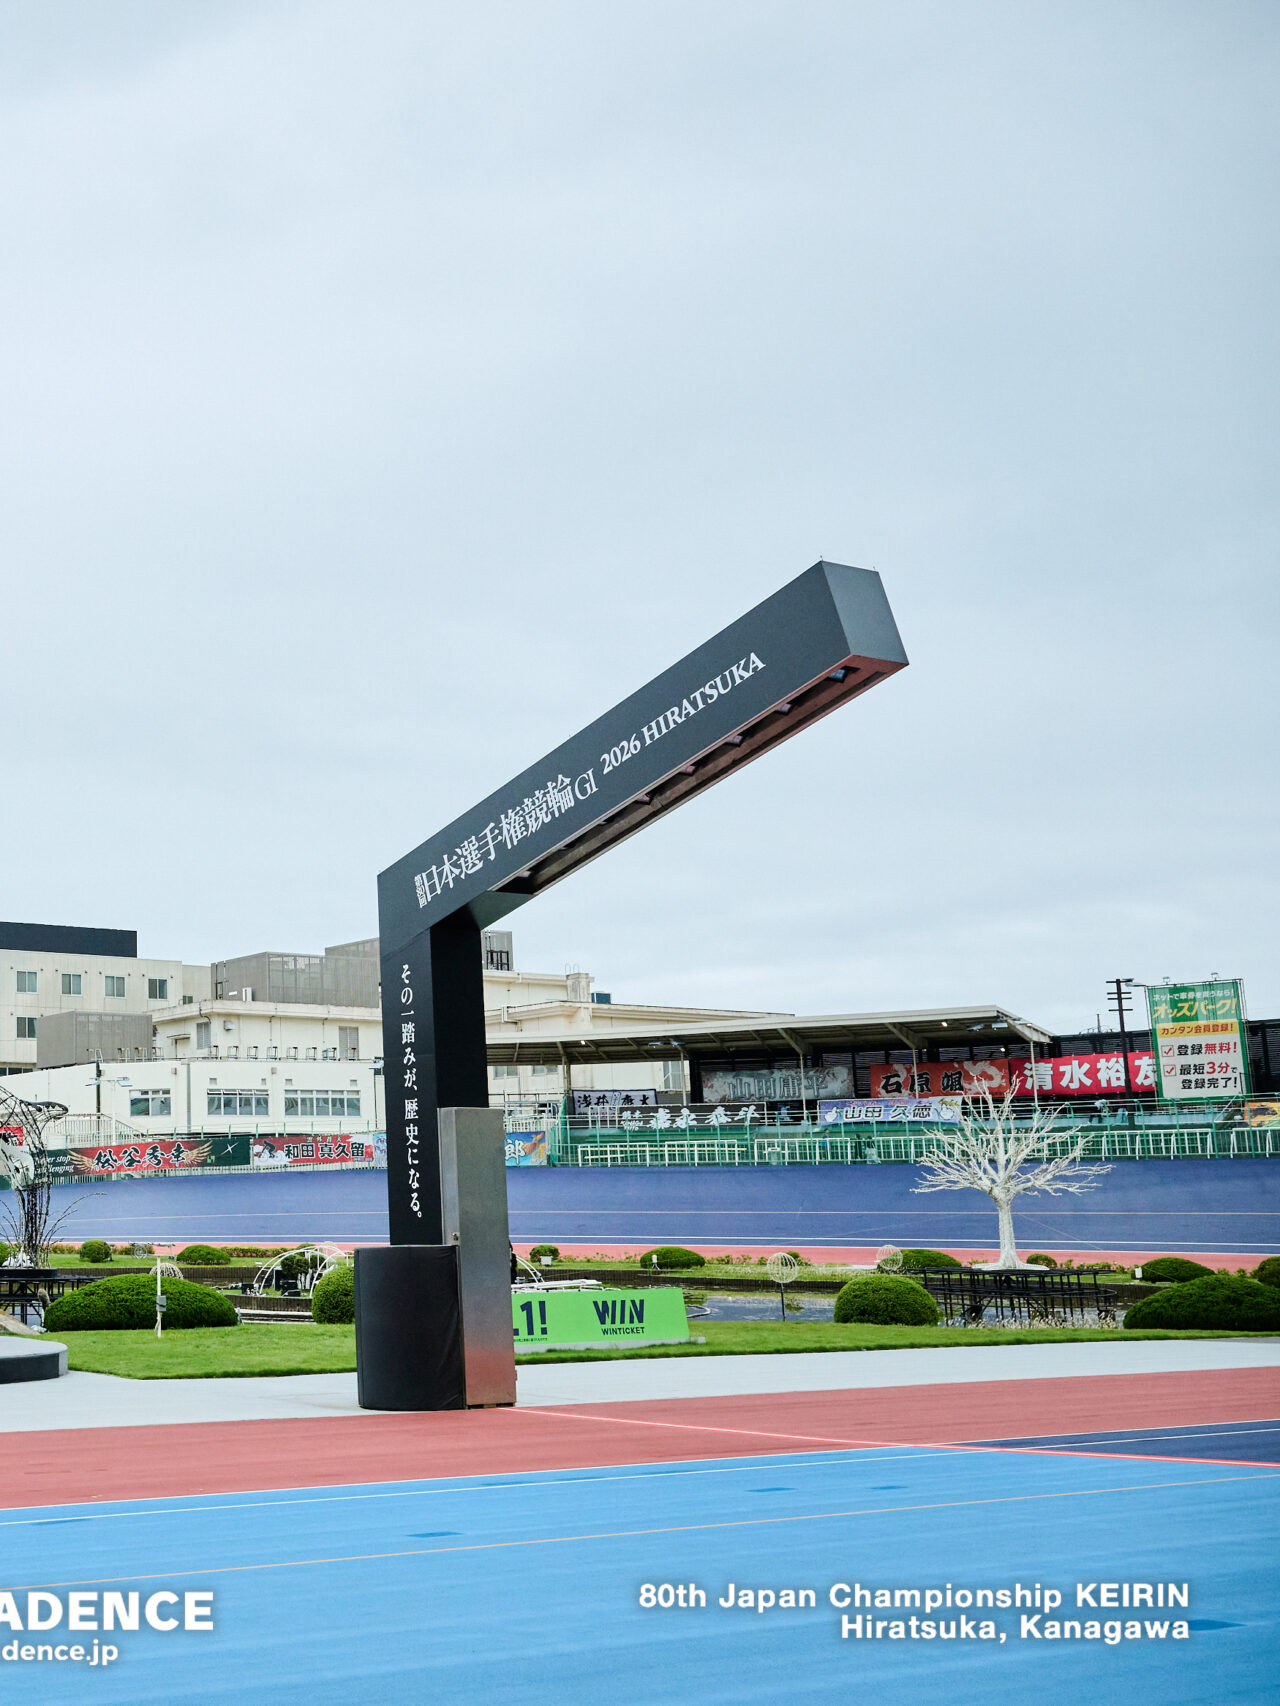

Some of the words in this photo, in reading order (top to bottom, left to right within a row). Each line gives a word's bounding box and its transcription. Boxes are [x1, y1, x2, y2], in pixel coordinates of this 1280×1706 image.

[600, 733, 642, 775] 2026
[641, 652, 766, 747] HIRATSUKA
[1179, 1061, 1238, 1076] 最短3分で
[400, 964, 422, 1218] その一踏みが、歴史になる。
[593, 1299, 645, 1325] WIN
[601, 1326, 645, 1336] WINTICKET
